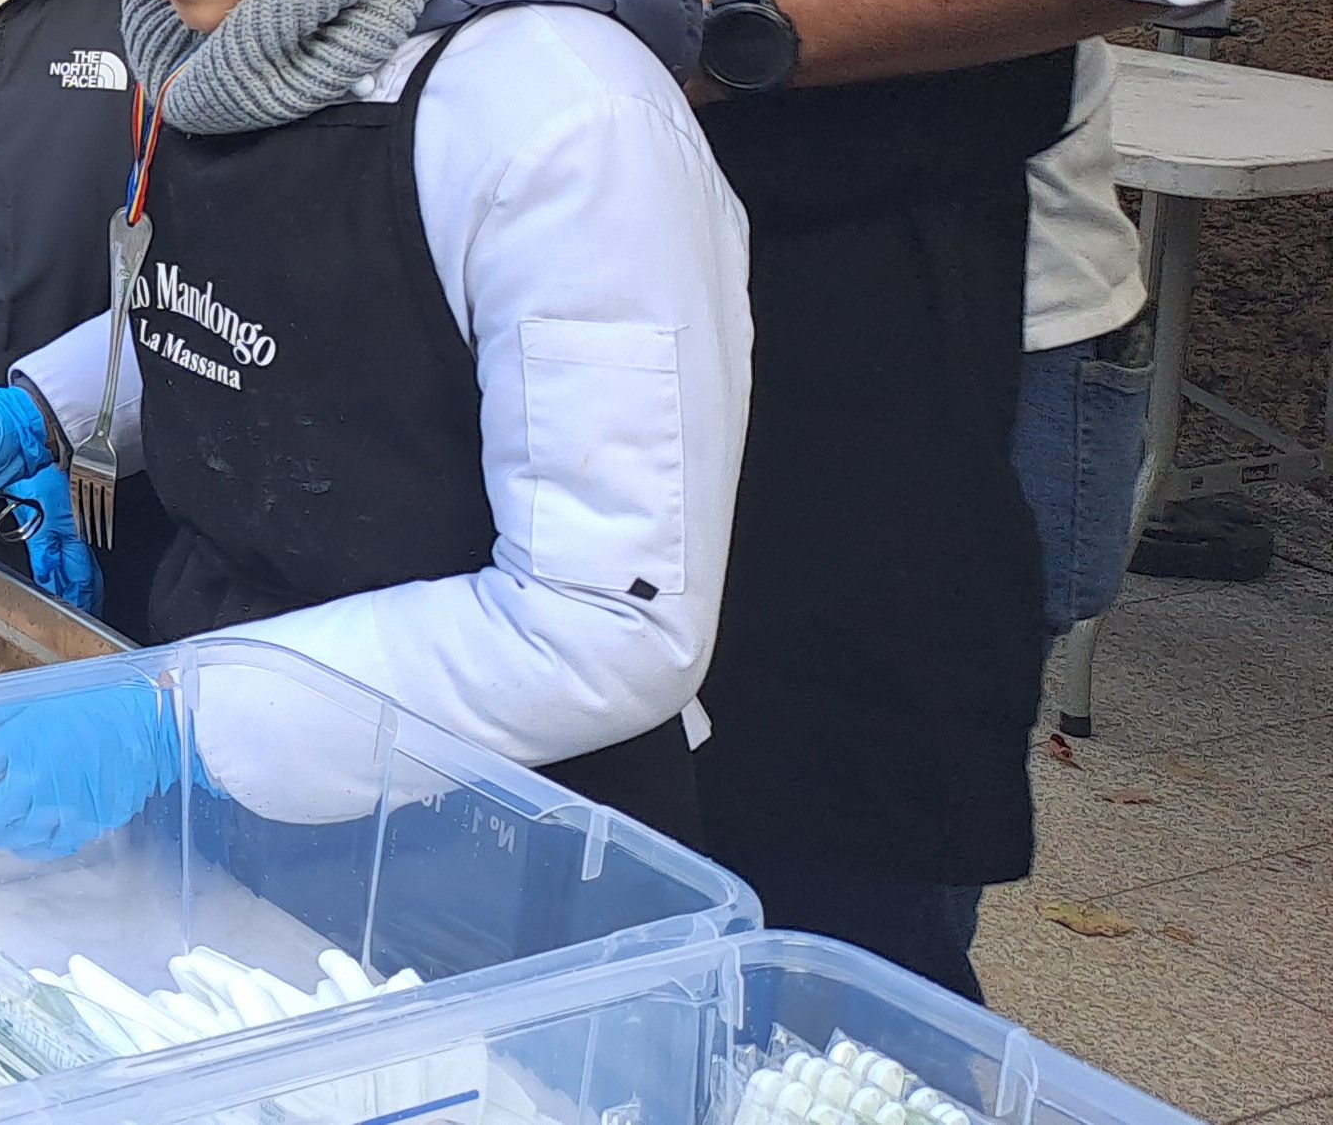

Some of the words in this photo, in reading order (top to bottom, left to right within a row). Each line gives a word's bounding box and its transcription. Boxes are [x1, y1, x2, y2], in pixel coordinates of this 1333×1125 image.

[71, 50, 101, 63] THE
[49, 62, 99, 76] NORTH
[61, 75, 98, 89] FACE
[155, 262, 277, 367] Mandongo
[139, 318, 161, 352] La
[161, 332, 242, 391] Massana
